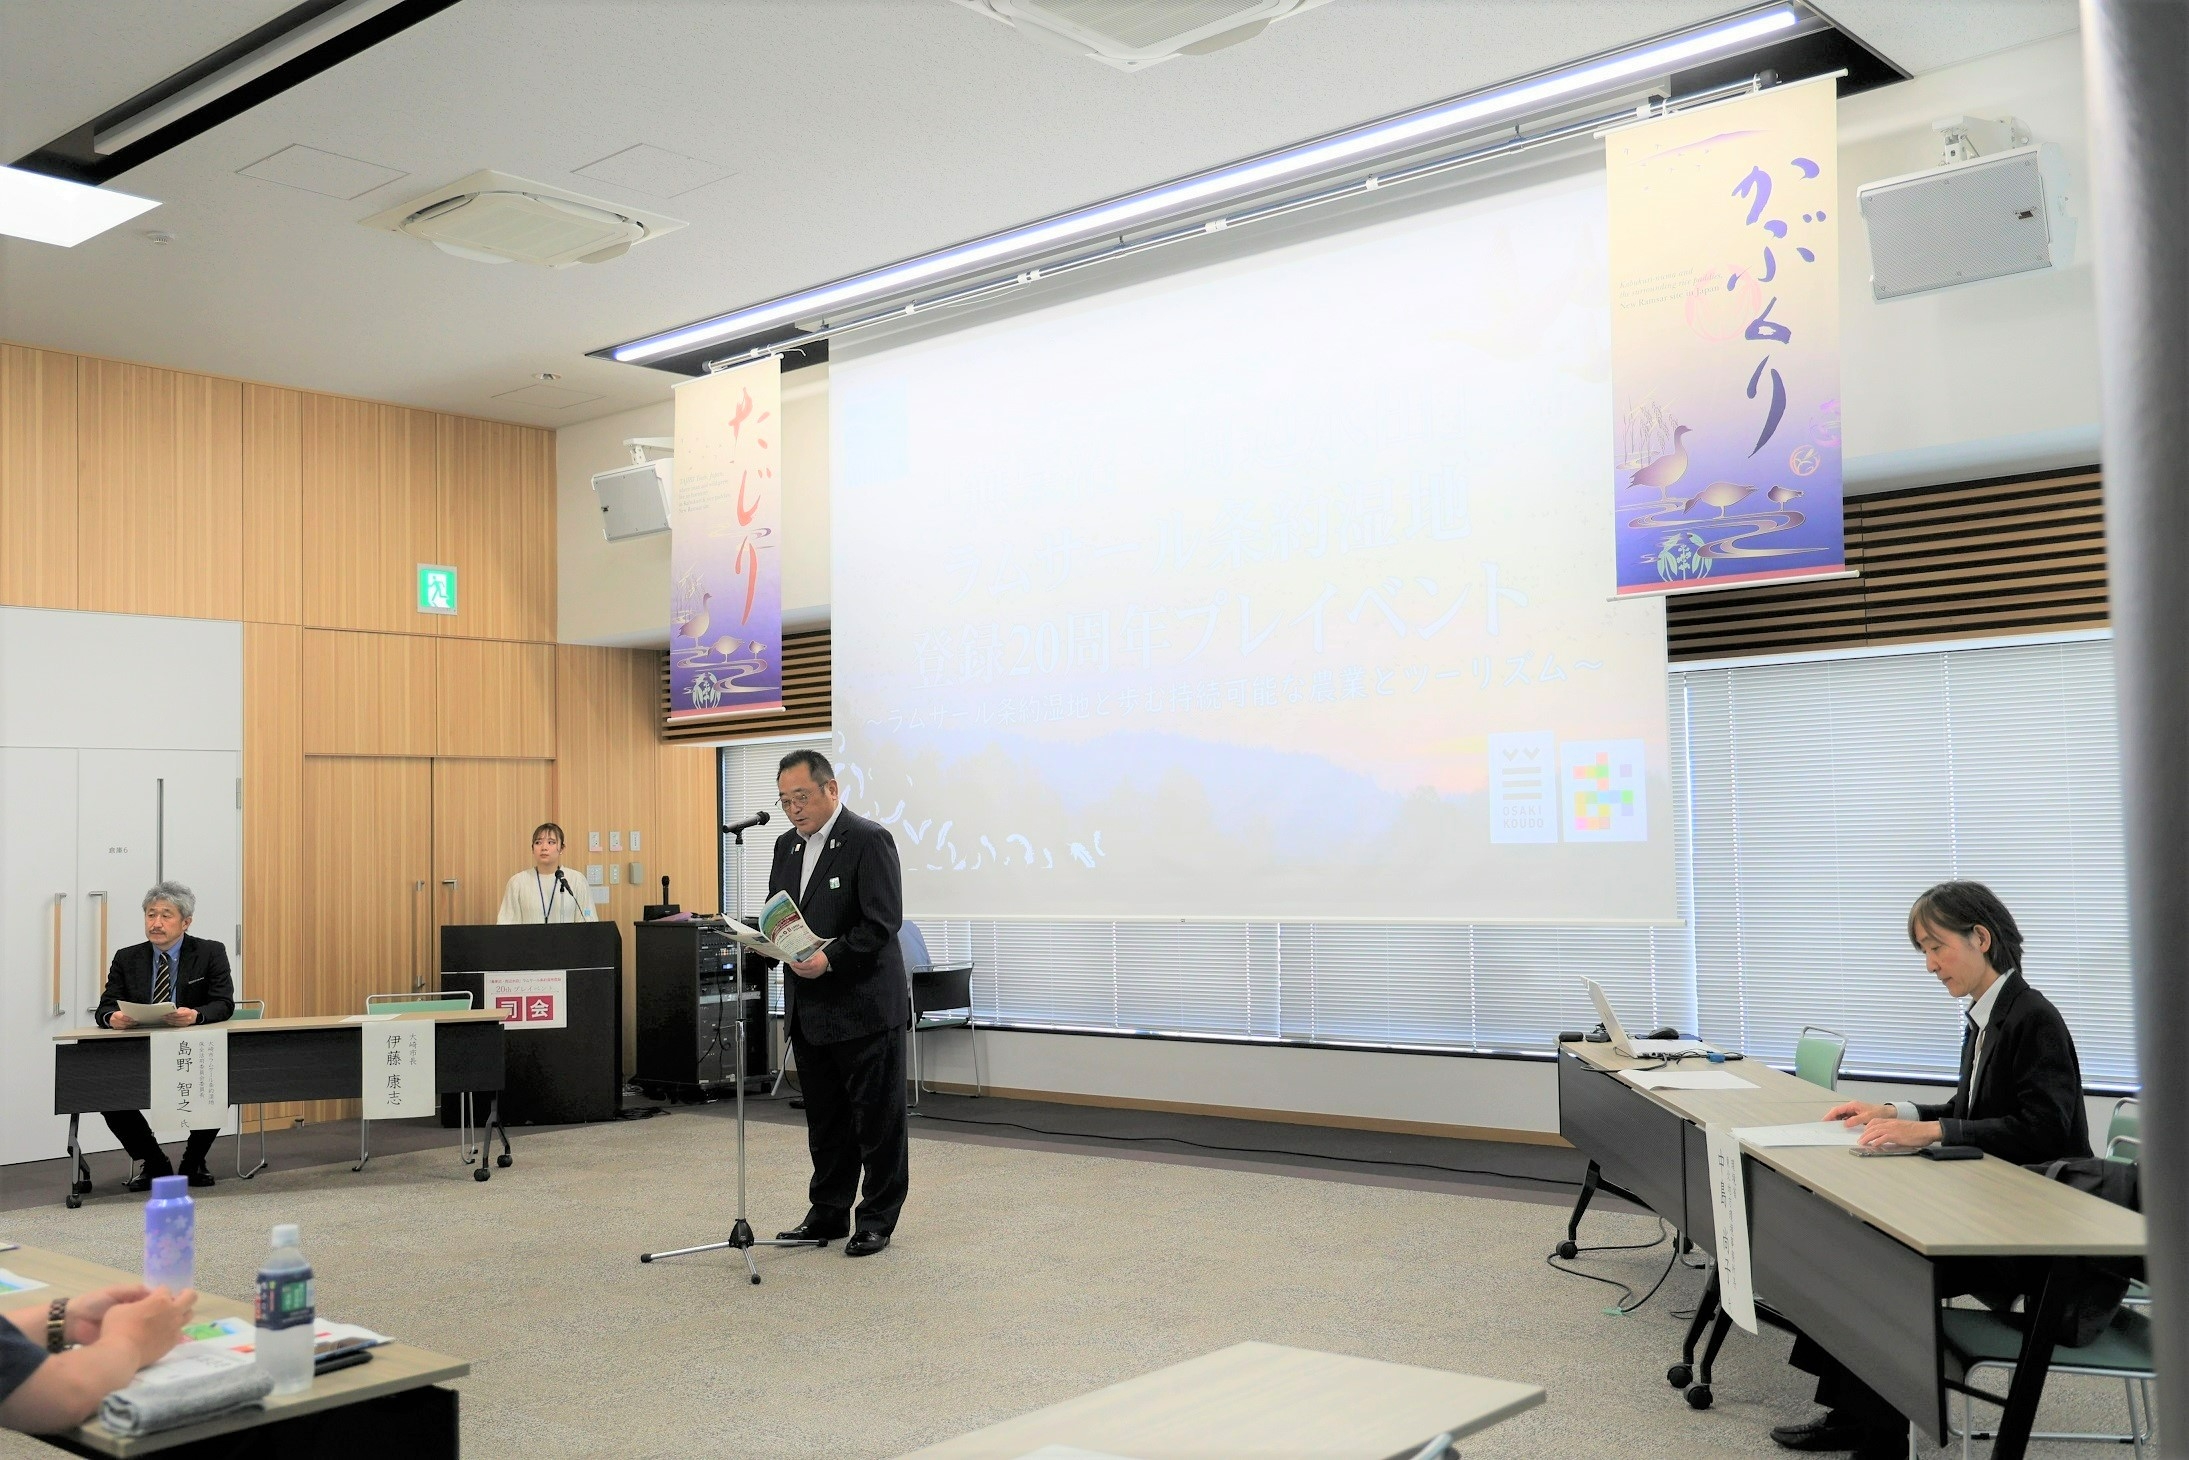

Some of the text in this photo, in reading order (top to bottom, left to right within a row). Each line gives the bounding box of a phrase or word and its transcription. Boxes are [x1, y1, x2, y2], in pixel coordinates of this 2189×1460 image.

[1678, 267, 1695, 278] and
[1620, 302, 1637, 311] New
[1638, 295, 1669, 308] Ramsar
[1669, 291, 1684, 302] site
[1694, 285, 1720, 298] Japan
[1632, 281, 1678, 296] surrounding
[728, 386, 772, 626] たじり
[912, 559, 1530, 690] 登録20周年プレイベント
[1502, 805, 1542, 816] OSAKI
[1503, 817, 1544, 829] KOUDO
[496, 985, 512, 993] 20th
[500, 999, 550, 1019] 司会
[408, 1033, 417, 1066] 大崎市長
[386, 1034, 402, 1106] 伊藤 康志
[176, 1040, 193, 1129] 島野 智之 氏
